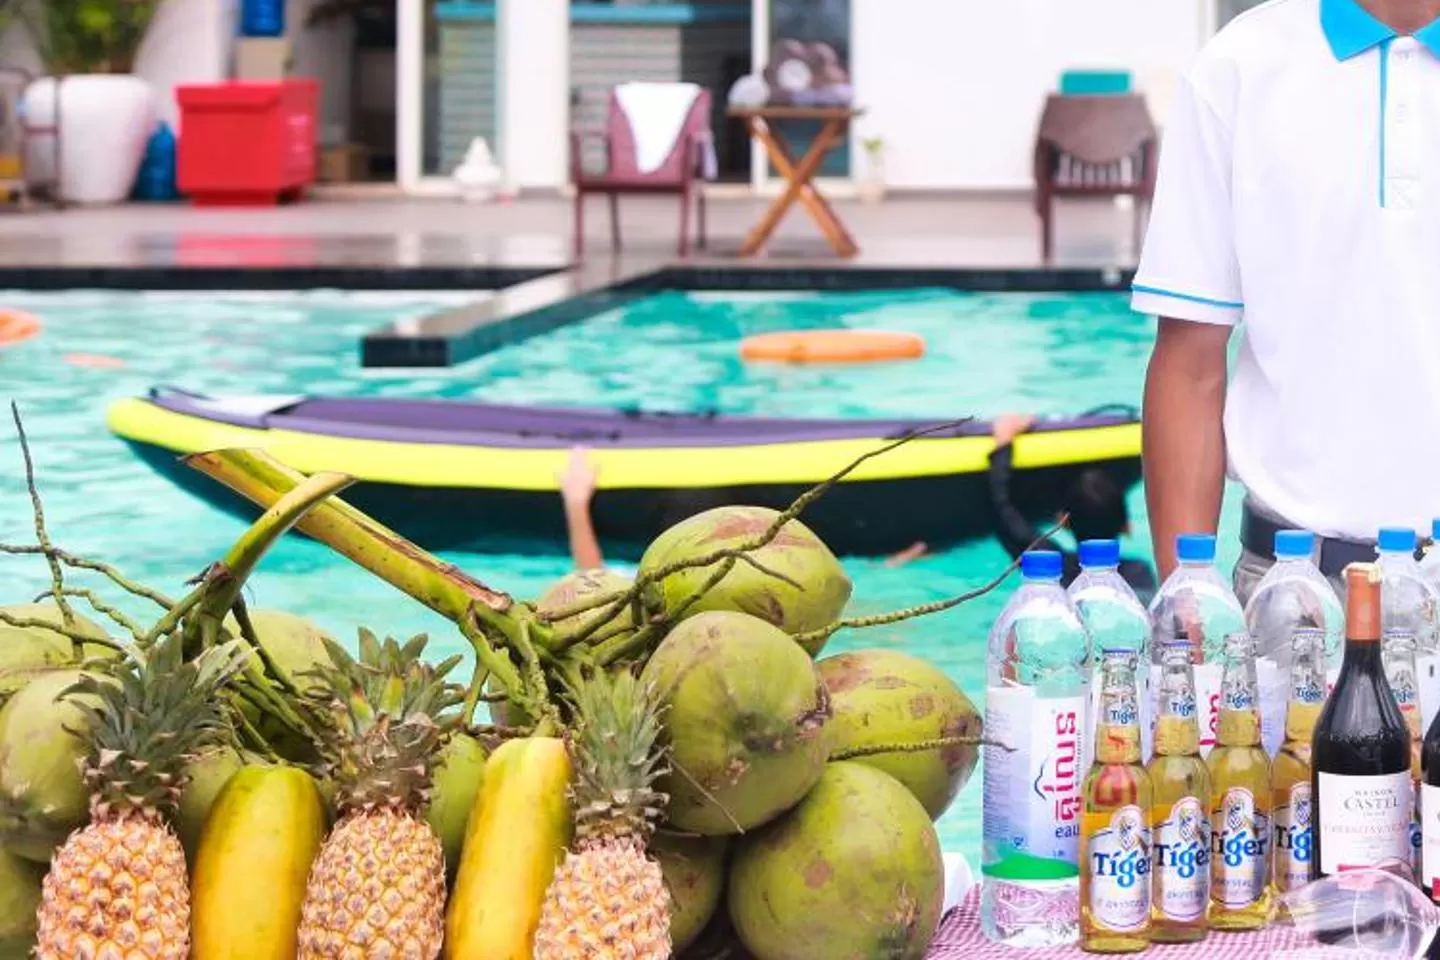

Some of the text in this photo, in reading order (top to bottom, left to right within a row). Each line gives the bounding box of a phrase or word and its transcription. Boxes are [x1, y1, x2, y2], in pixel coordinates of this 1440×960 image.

[1110, 709, 1137, 724] Tiger
[1171, 701, 1196, 717] Tiger
[1343, 797, 1401, 813] CASTEL
[1055, 824, 1081, 838] eau
[1211, 830, 1267, 867] Tiger
[1275, 824, 1312, 861] Tig
